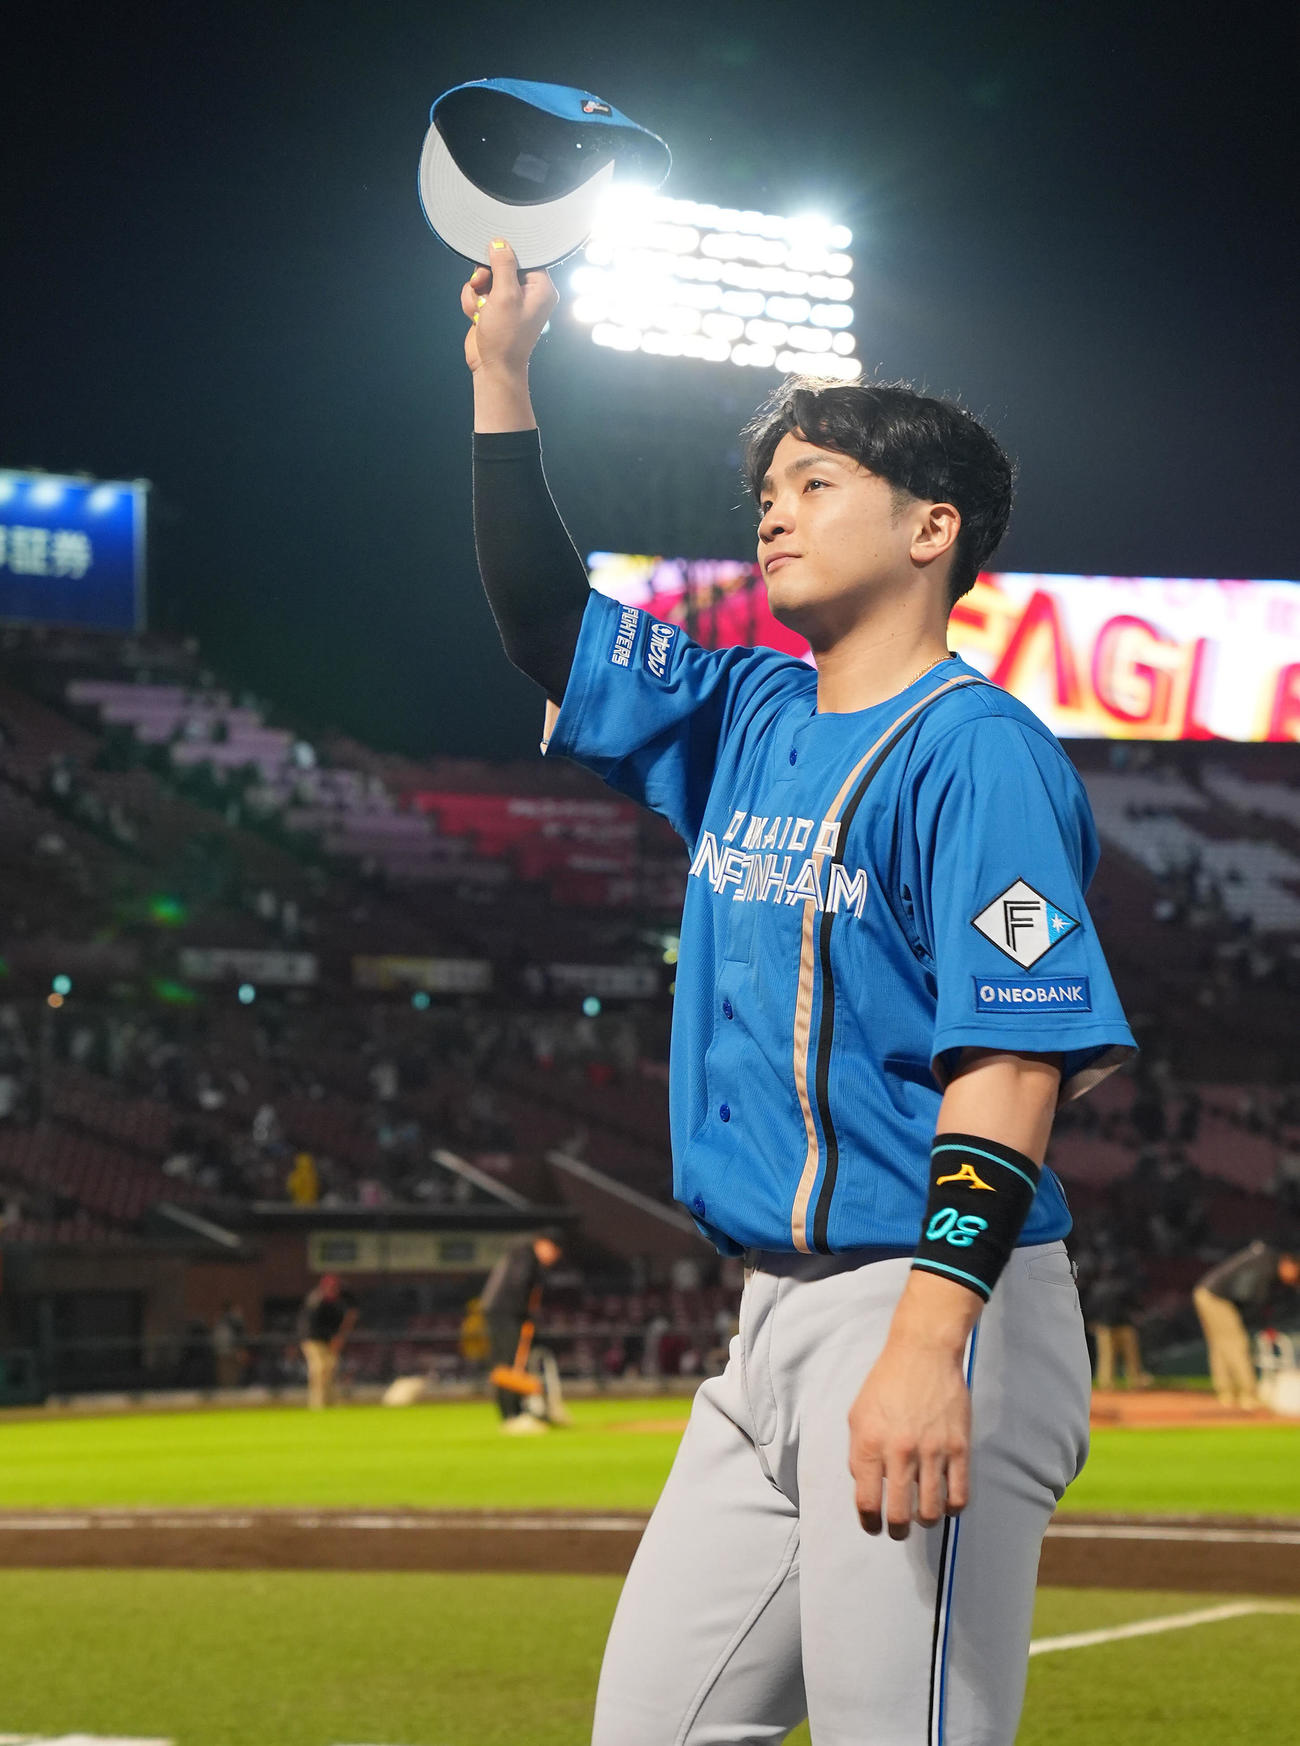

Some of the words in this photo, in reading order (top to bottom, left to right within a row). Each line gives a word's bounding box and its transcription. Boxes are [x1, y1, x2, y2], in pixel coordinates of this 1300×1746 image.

[0, 525, 92, 580] 証券
[611, 606, 639, 667] FIGHTERS
[648, 632, 671, 678] ホクレン
[1003, 901, 1041, 952] F
[997, 985, 1084, 1003] NEOBANK
